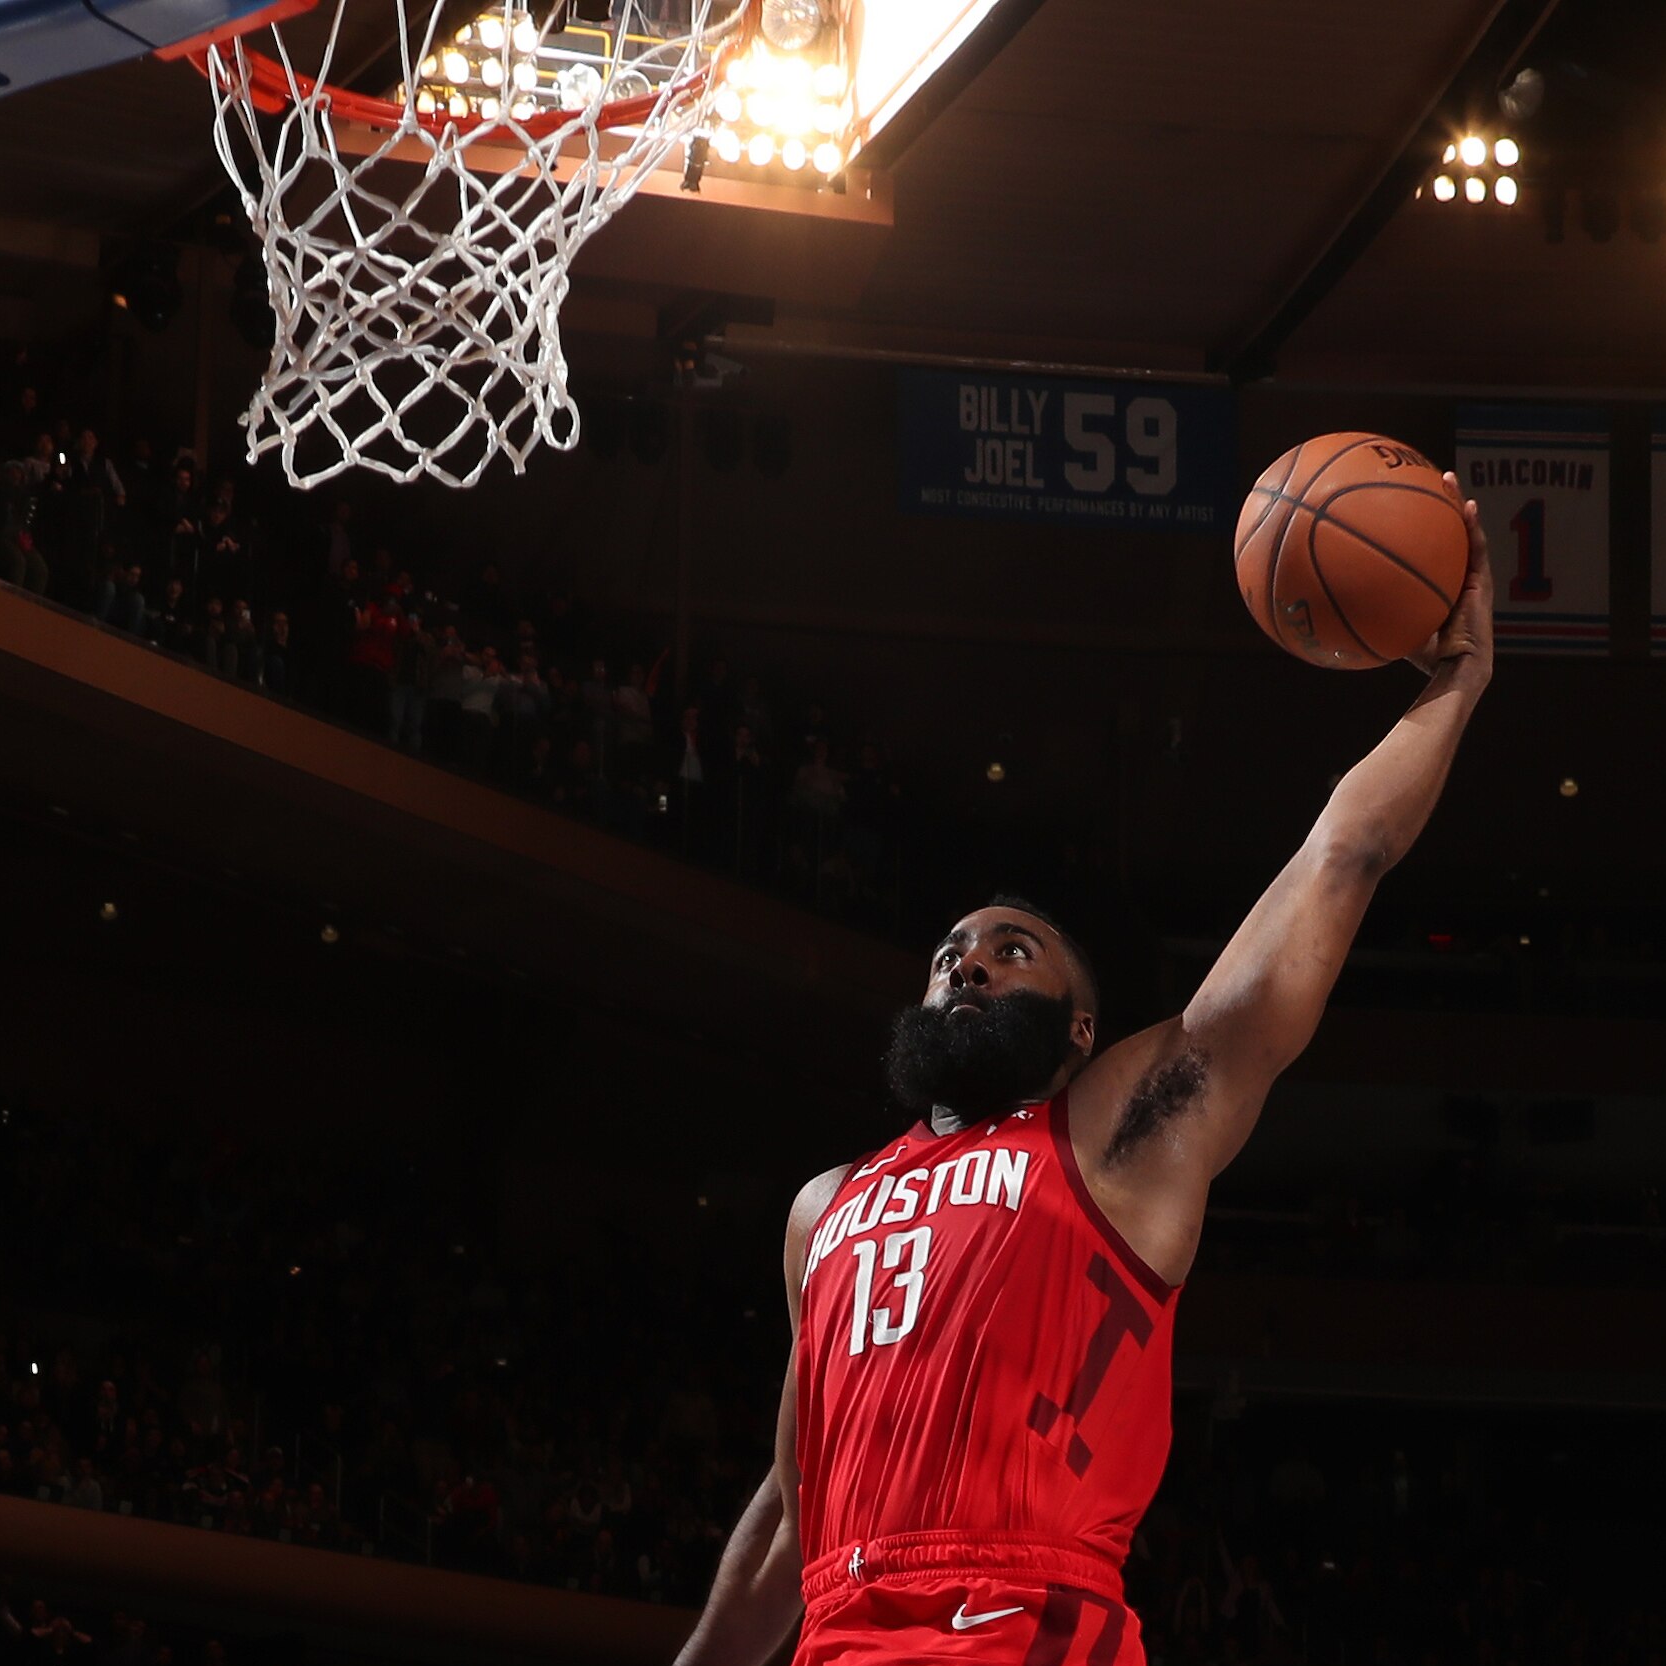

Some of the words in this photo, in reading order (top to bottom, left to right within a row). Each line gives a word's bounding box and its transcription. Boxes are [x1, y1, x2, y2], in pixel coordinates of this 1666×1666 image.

[958, 384, 1049, 436] BILLY
[1063, 391, 1177, 496] 59
[964, 438, 1045, 489] JOEL
[1470, 459, 1593, 492] GIACOMIN
[921, 487, 950, 504] MOST
[956, 489, 1032, 510] CONSECUTIVE
[1036, 493, 1126, 518] PERFORMANCES
[1129, 501, 1143, 517] BY
[1148, 503, 1171, 519] ANY
[1176, 505, 1214, 523] ARTIST
[1509, 498, 1553, 602] 1
[801, 1147, 1029, 1292] HOUSTON
[847, 1225, 933, 1358] 13
